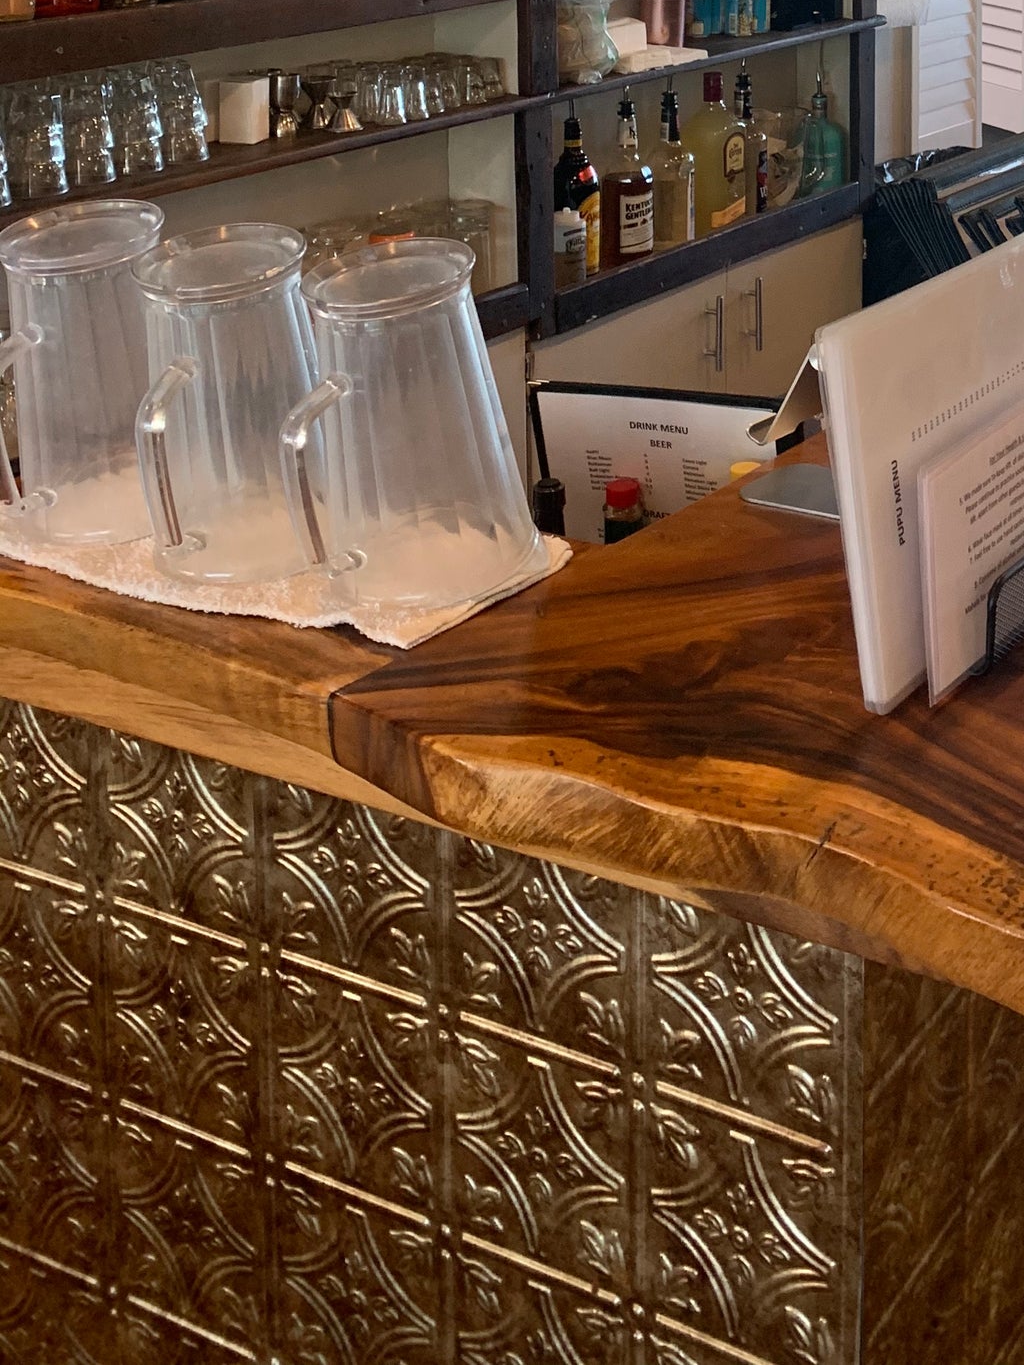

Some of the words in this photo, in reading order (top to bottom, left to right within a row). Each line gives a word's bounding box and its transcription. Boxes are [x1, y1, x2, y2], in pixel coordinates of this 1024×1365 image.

[629, 421, 659, 432] DRINK
[660, 424, 689, 435] MENU
[649, 438, 673, 450] BEER
[891, 459, 903, 504] MENU
[895, 507, 906, 546] PUPU
